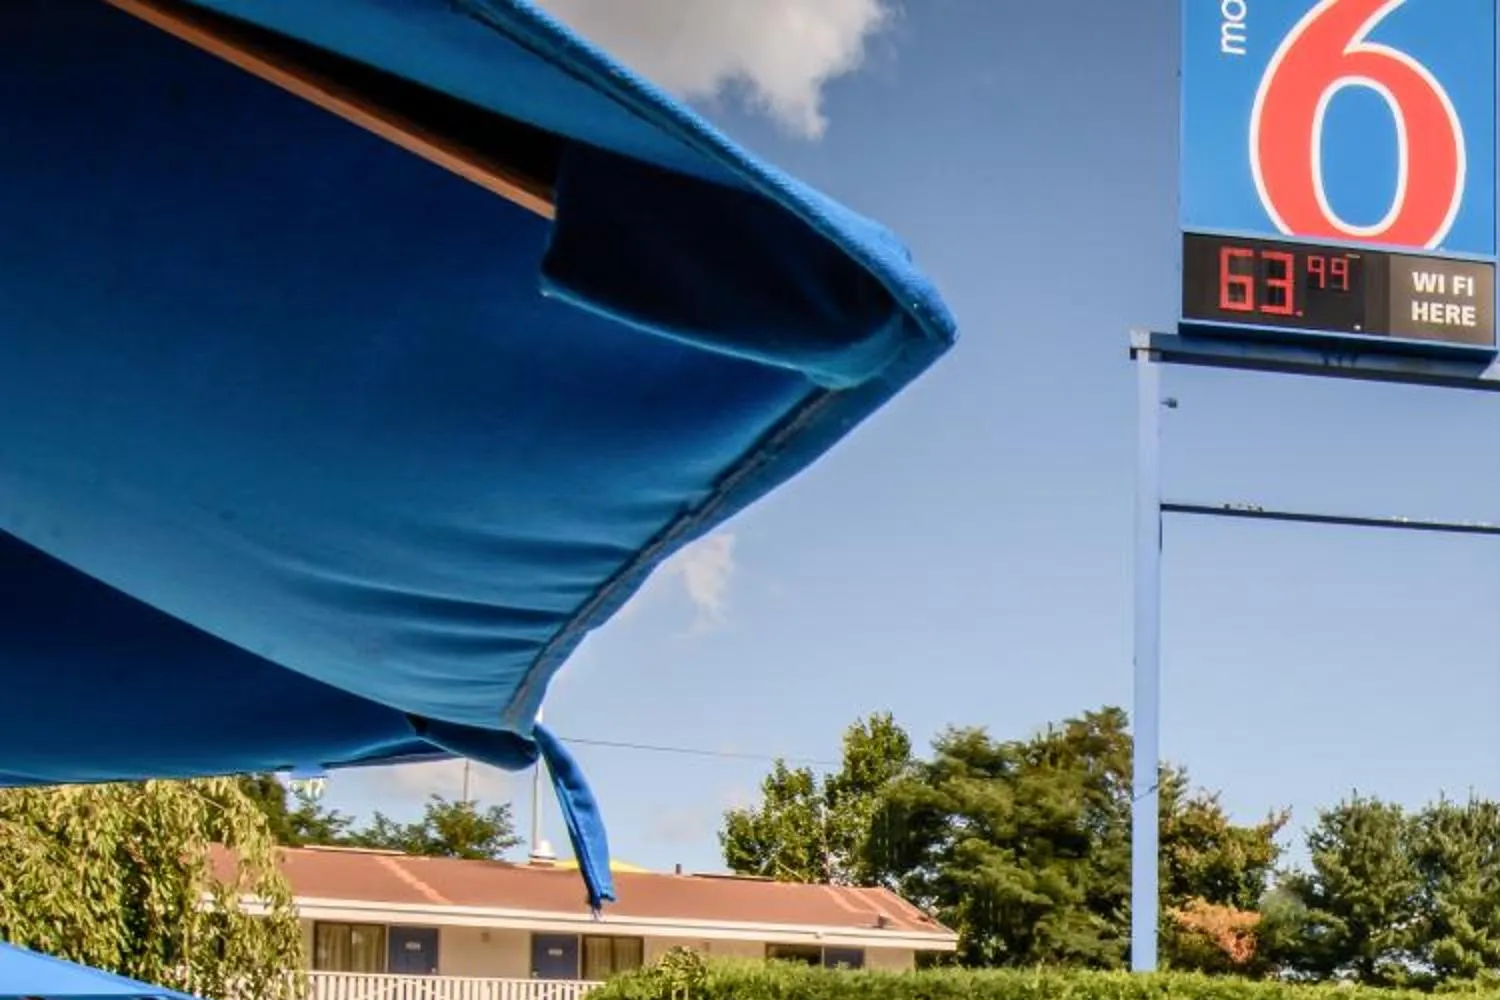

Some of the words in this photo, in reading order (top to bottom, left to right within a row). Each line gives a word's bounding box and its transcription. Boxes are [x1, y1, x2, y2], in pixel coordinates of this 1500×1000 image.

[1250, 0, 1467, 251] 6
[1412, 271, 1445, 293] WI
[1453, 275, 1474, 297] FI
[1411, 301, 1476, 327] HERE
